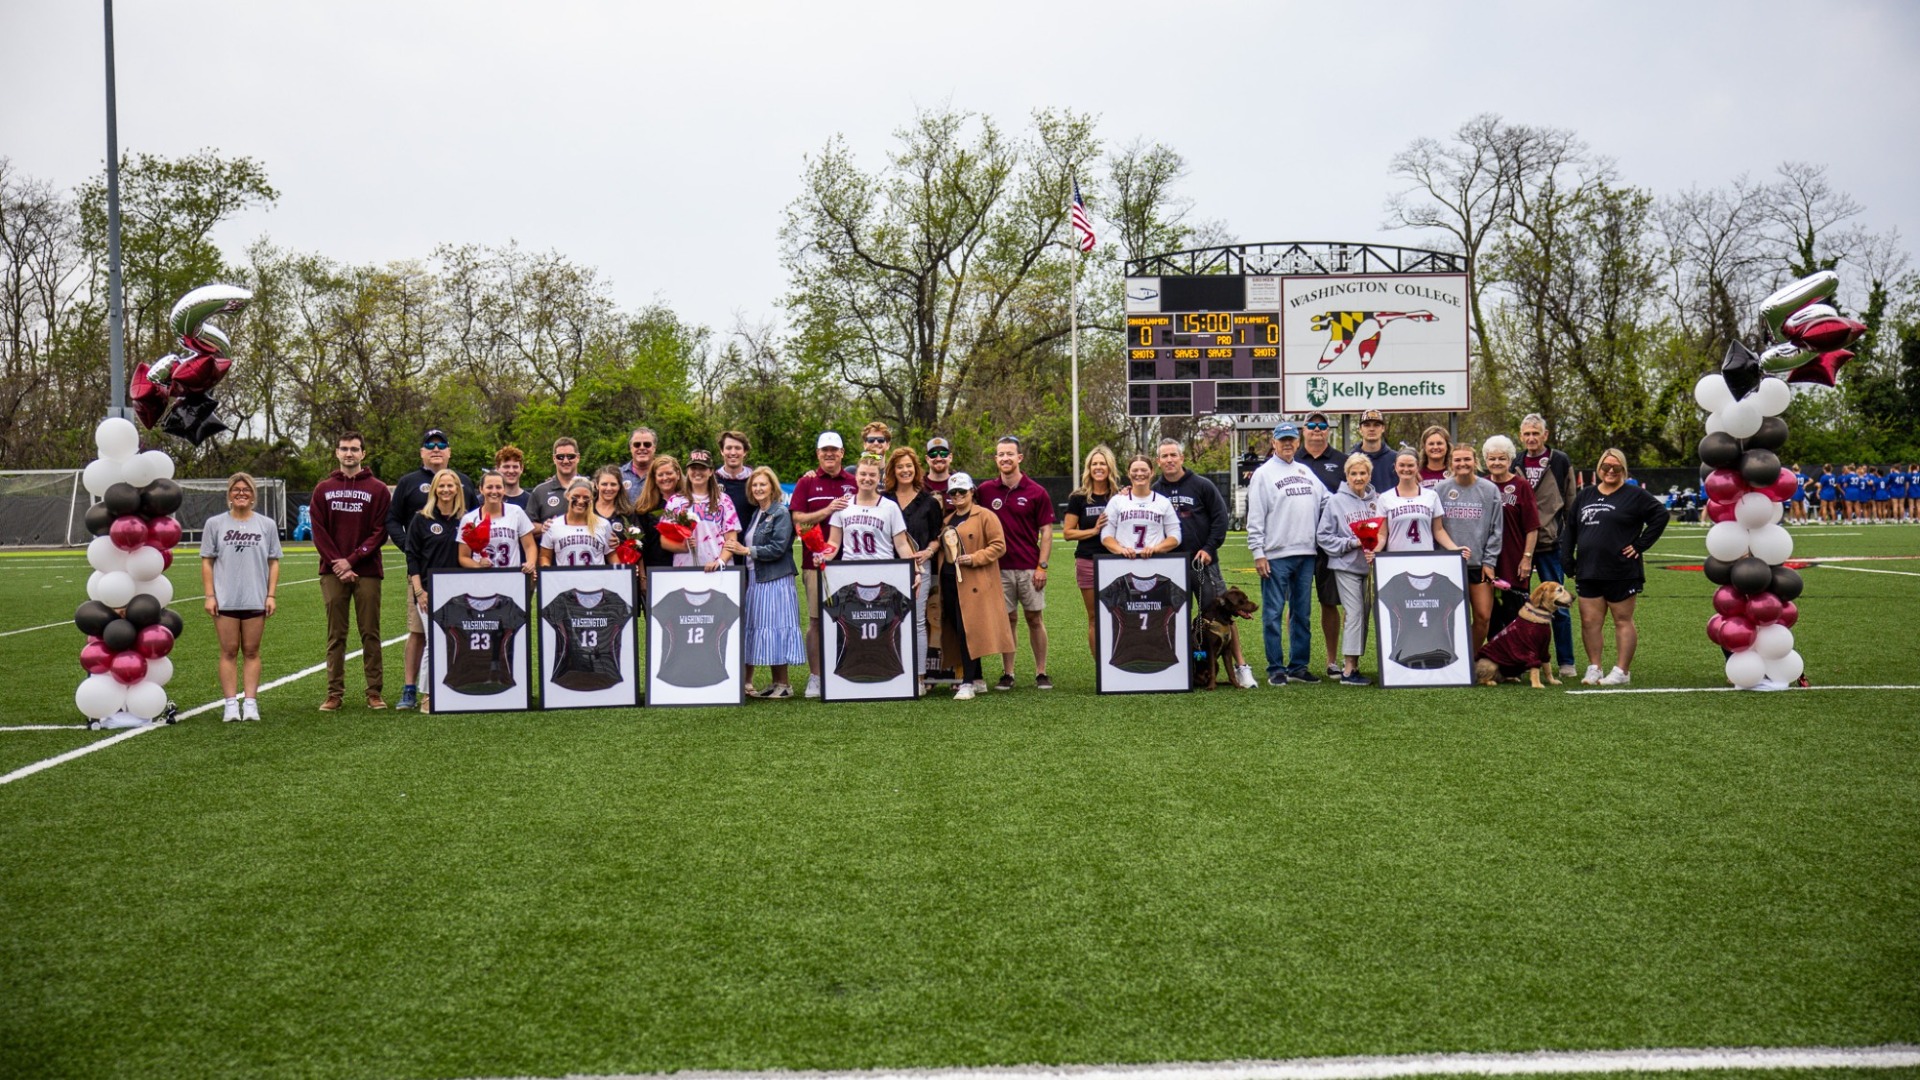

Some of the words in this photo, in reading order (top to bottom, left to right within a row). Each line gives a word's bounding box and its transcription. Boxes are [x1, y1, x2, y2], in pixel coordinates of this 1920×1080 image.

[1290, 281, 1388, 308] WASHINGTON
[1395, 283, 1461, 308] COLLEGE
[1183, 313, 1231, 333] 15:00
[1140, 326, 1152, 346] 0
[1240, 329, 1245, 344] 1
[1267, 324, 1279, 344] 0
[1132, 349, 1155, 359] SHOTS
[1174, 349, 1199, 359] SAVES
[1207, 348, 1232, 358] SAVES
[1253, 348, 1277, 358] SHOTS
[1332, 381, 1374, 399] Kelly
[1378, 380, 1446, 396] Benefits
[1274, 475, 1314, 490] WASHINGTON
[324, 490, 372, 503] WASHINGTON
[1285, 486, 1312, 497] COLLEGE
[331, 501, 363, 512] COLLEGE
[1391, 504, 1431, 519] WASHINGTON
[1443, 506, 1483, 519] LACROSSE
[844, 515, 885, 532] WASHINGTON
[1120, 509, 1162, 523] WASHINGTON
[223, 530, 262, 542] Shore
[490, 527, 515, 540] INGTON
[1133, 524, 1148, 549] 7
[1406, 519, 1421, 544] 4
[559, 534, 600, 550] WASHINGTON
[851, 530, 877, 555] 10
[1126, 601, 1161, 611] WASHINGTON
[1404, 599, 1440, 609] WASHINGTON
[679, 615, 714, 625] WASHINGTON
[851, 610, 887, 620] WASHINGTON
[1139, 613, 1148, 630] 7
[1418, 611, 1428, 628] 4
[461, 620, 499, 630] WASHINGTON
[571, 618, 608, 628] WASHINGTON
[580, 630, 598, 647] 13
[687, 627, 704, 644] 12
[861, 623, 878, 640] 10
[470, 633, 491, 650] 23
